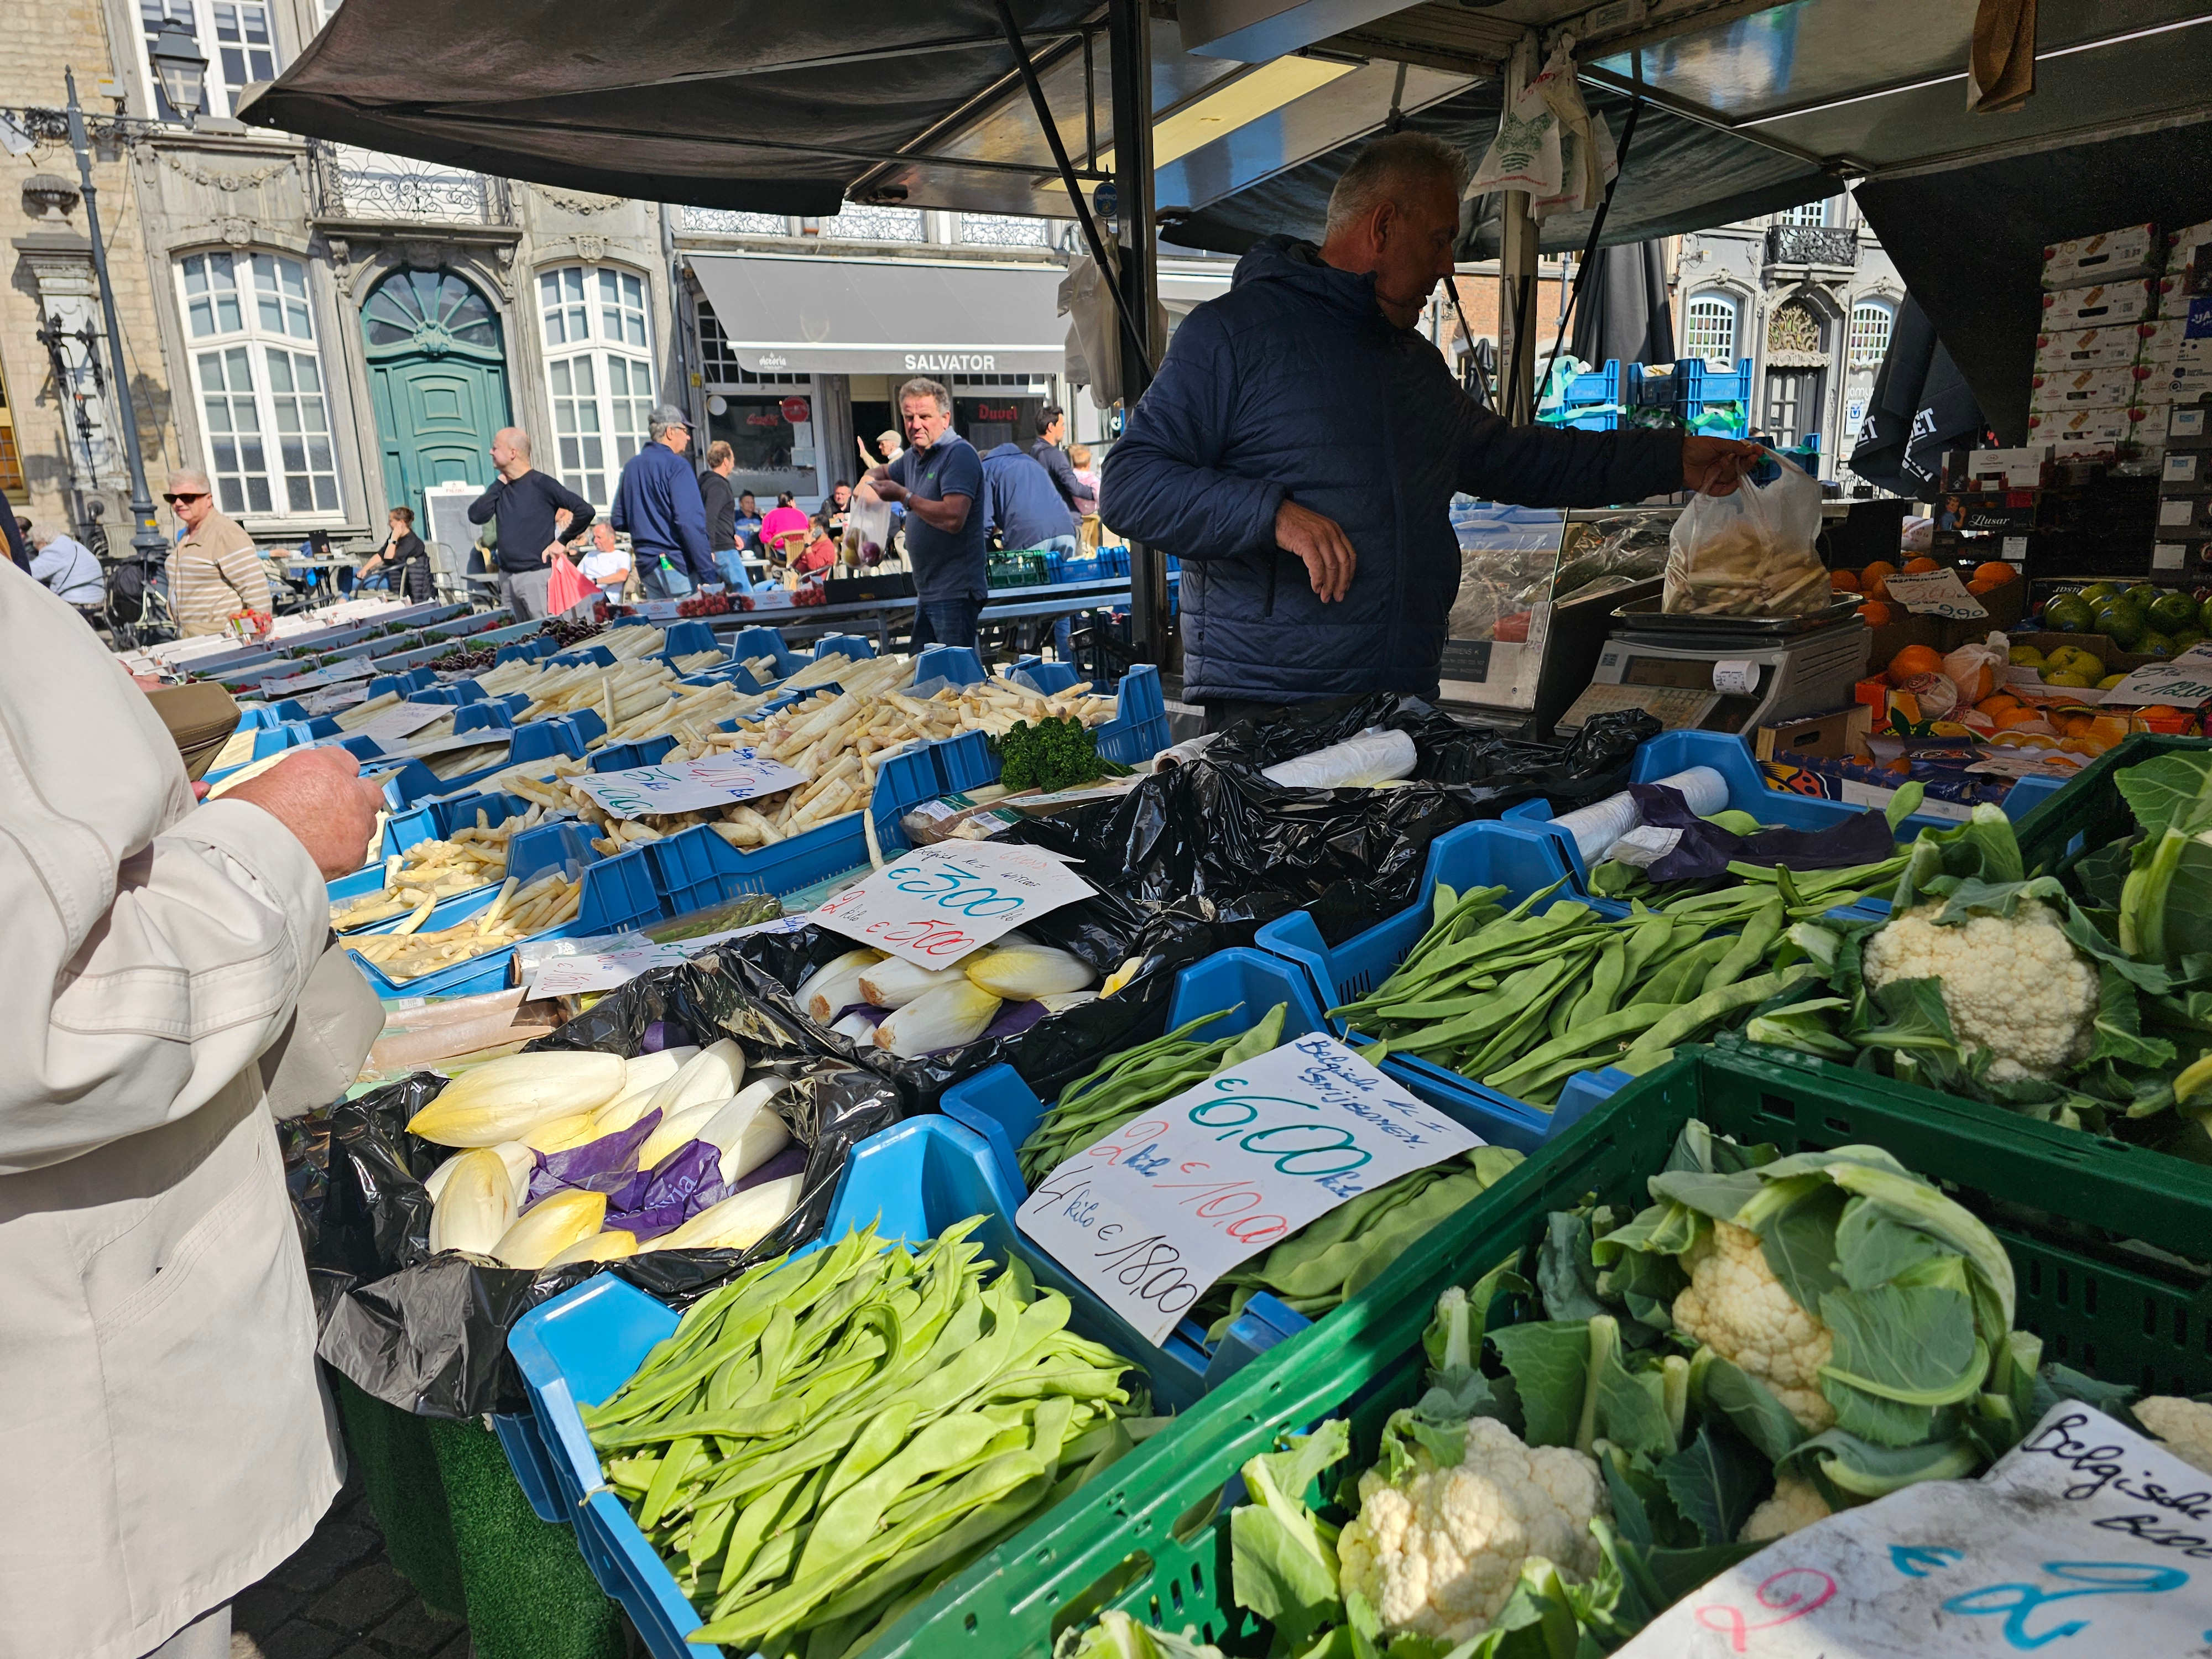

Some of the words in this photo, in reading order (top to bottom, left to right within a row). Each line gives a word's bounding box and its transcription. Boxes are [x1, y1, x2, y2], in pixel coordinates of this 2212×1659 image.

[905, 354, 995, 371] SALVATOR
[979, 403, 1018, 421] Duvel
[1969, 514, 2010, 528] Llusar
[821, 890, 865, 914] 2
[1088, 1120, 1170, 1166] 2
[1694, 1568, 1838, 1654] 2
